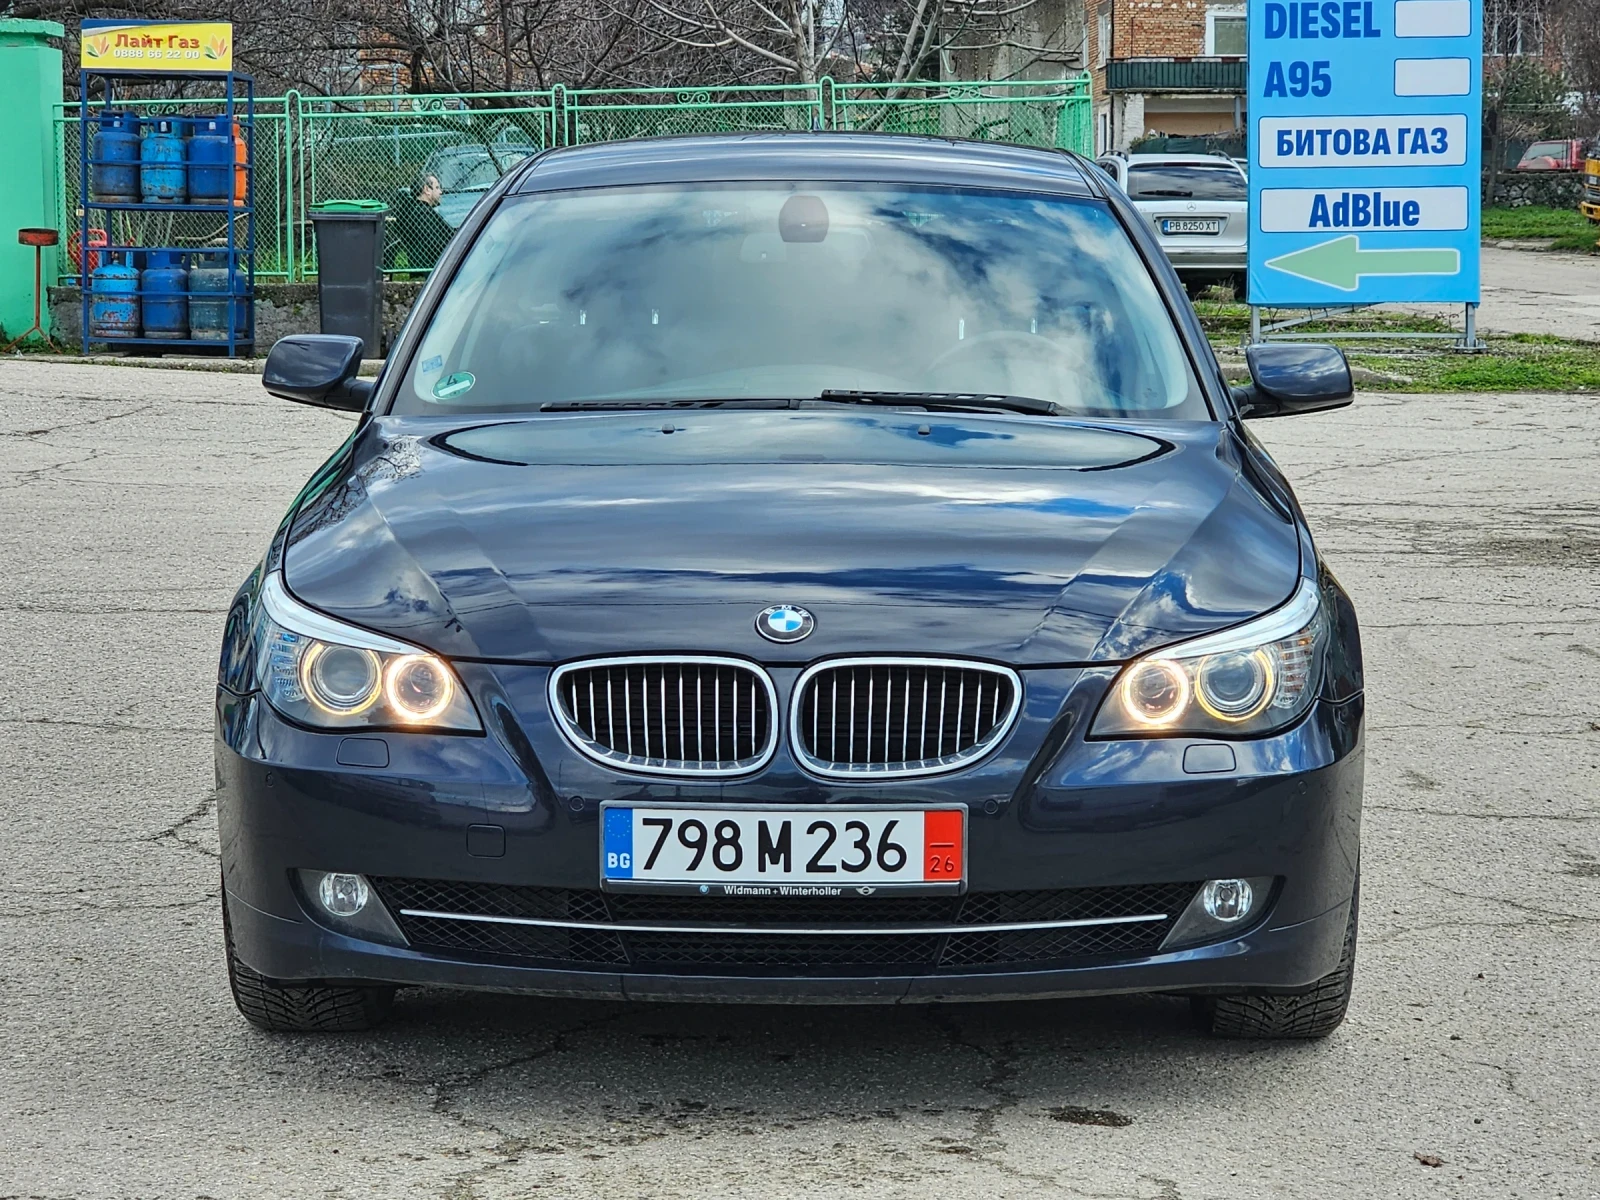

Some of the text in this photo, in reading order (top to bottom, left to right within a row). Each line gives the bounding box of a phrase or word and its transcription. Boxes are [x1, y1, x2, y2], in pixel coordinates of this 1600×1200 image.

[1264, 1, 1381, 39] DIESEL
[114, 33, 200, 49] Лайт Газ
[113, 49, 200, 60] 0888 66 22 00
[1263, 60, 1332, 98] A95
[1276, 127, 1449, 156] БИТОВА ГАЗ
[1308, 192, 1420, 228] AdBlue
[1182, 221, 1204, 231] 8250
[1205, 221, 1217, 231] XT
[642, 817, 907, 873] 798 M 236
[607, 852, 631, 869] BG
[929, 855, 955, 873] 26
[724, 885, 771, 896] Widmann
[780, 885, 842, 897] Winterholler
